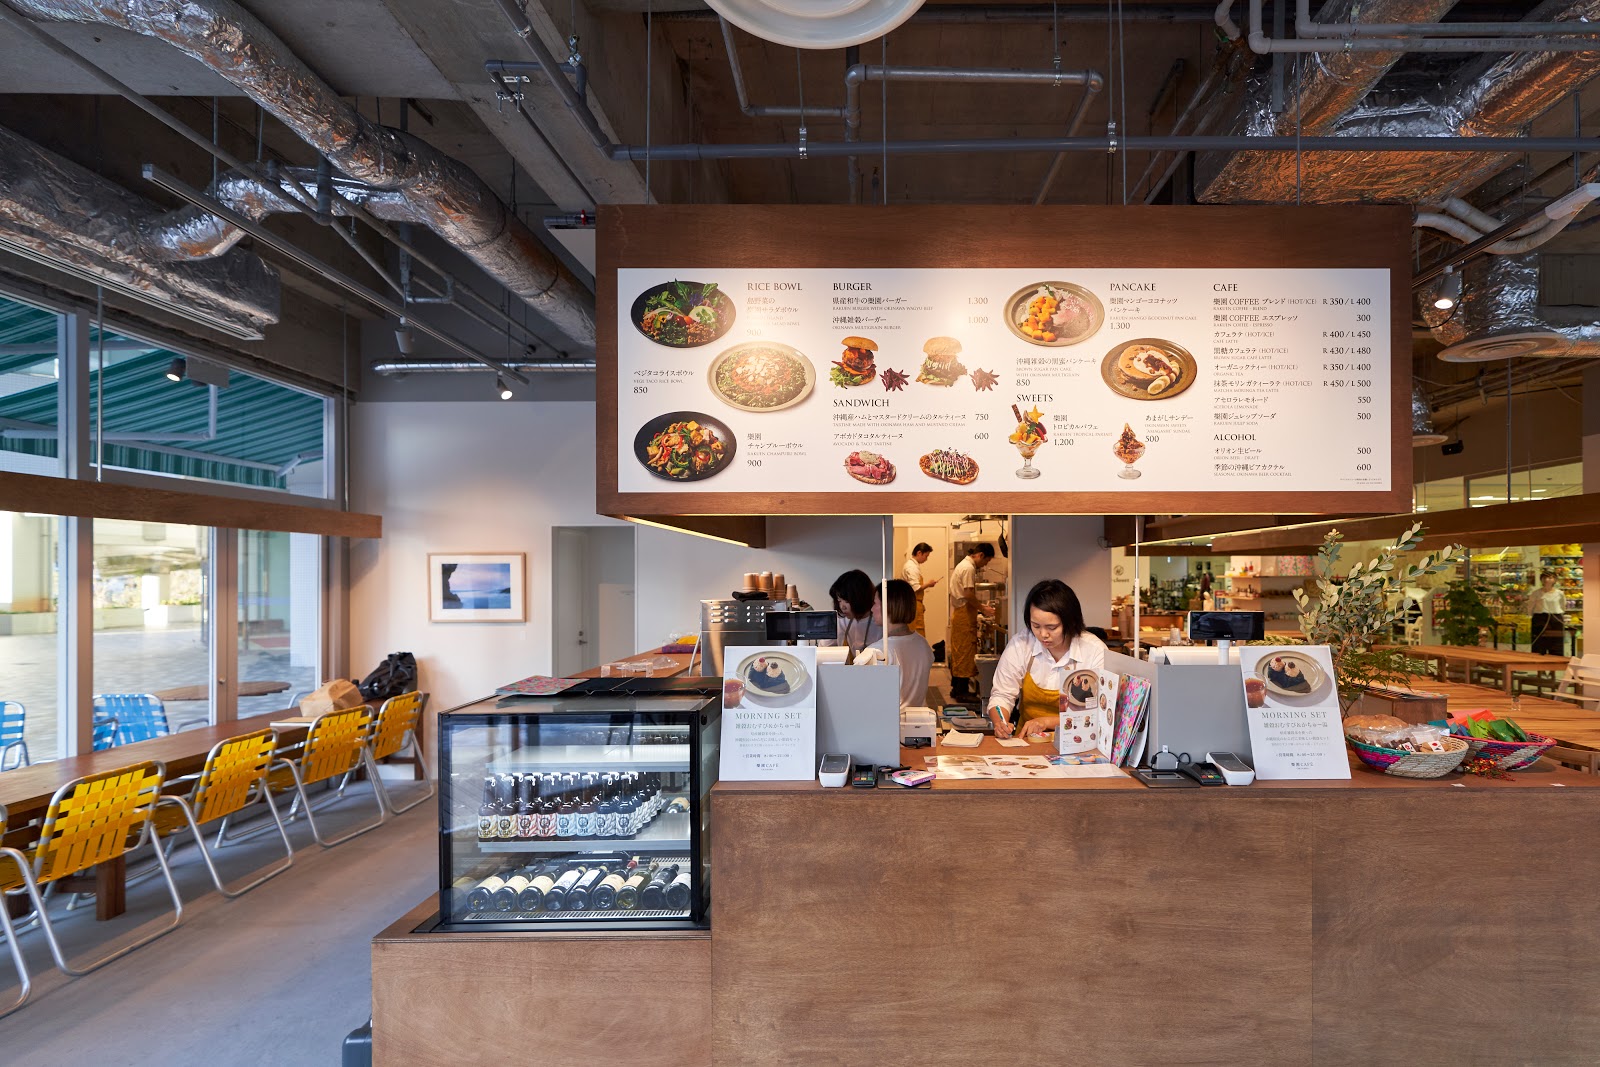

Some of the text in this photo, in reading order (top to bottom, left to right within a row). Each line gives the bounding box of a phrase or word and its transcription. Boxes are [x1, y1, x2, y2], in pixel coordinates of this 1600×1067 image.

[1213, 284, 1238, 292] CAFE
[1016, 394, 1054, 402] SWEETS
[833, 399, 890, 407] SANDWICH
